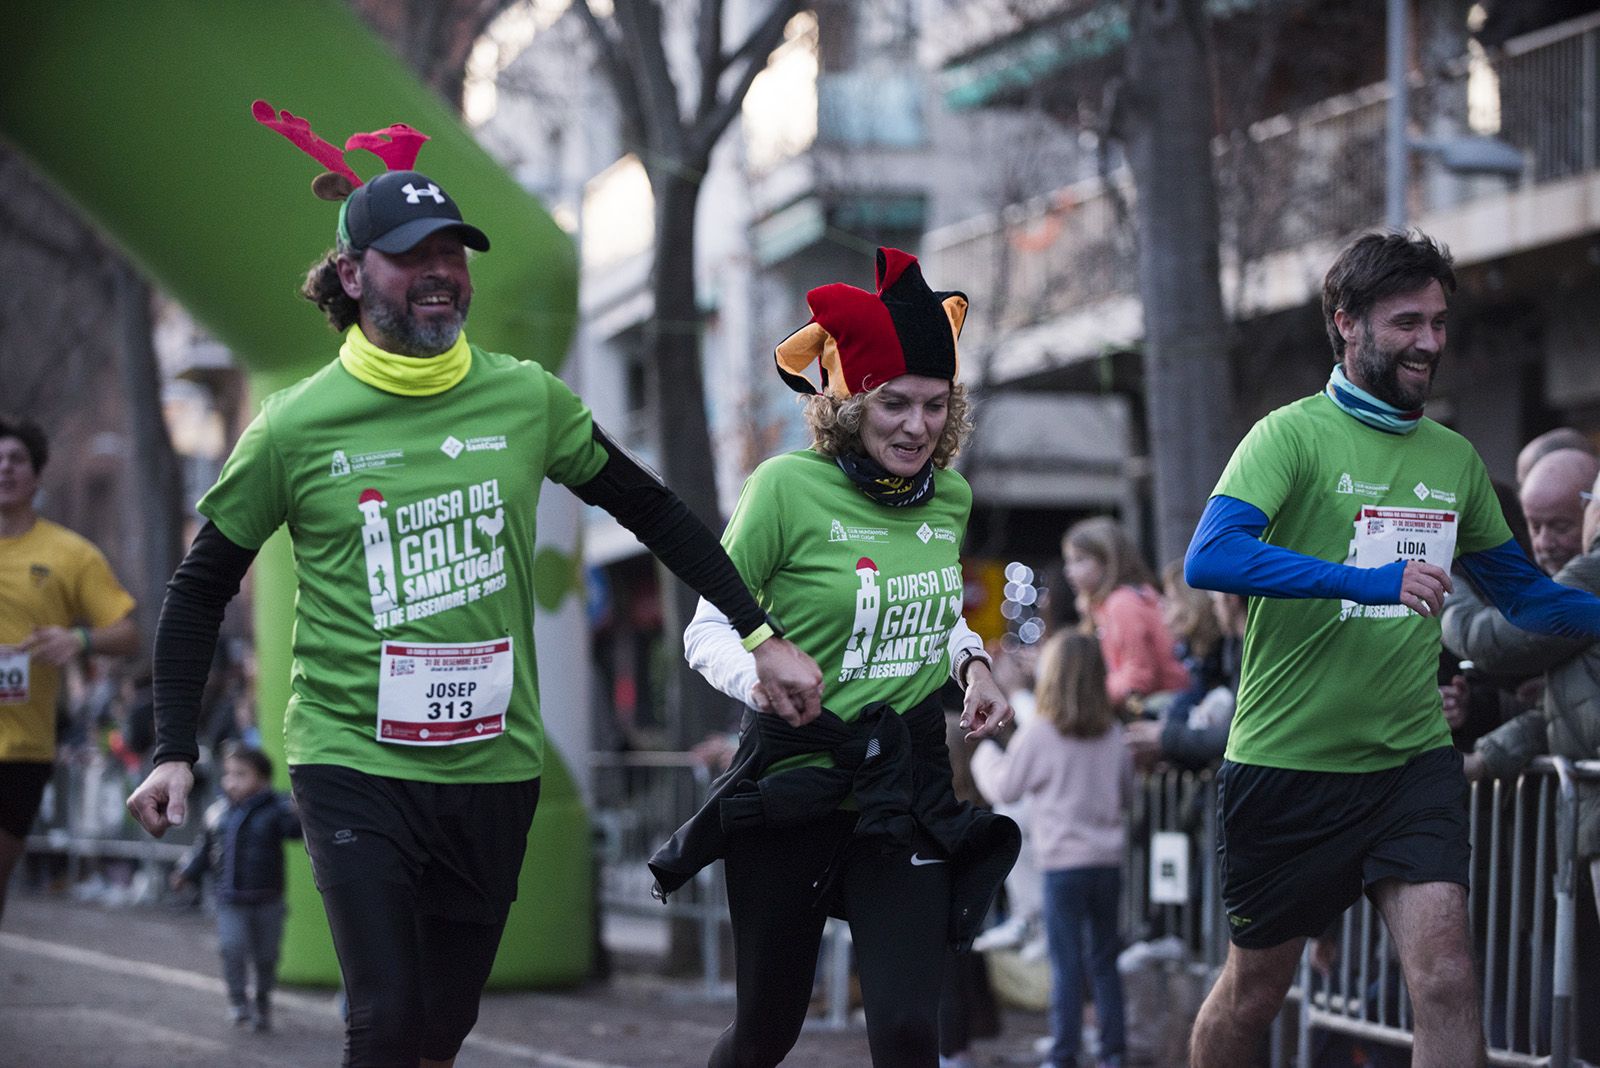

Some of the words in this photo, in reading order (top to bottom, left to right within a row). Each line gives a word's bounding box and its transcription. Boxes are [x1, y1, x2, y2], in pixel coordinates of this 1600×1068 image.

[396, 490, 464, 534] CURSA
[469, 479, 503, 513] DEL
[400, 518, 480, 576] GALL
[1396, 538, 1426, 556] LÍDIA
[403, 567, 451, 603] SANT
[454, 546, 505, 587] CUGAT
[887, 570, 940, 602] CURSA
[373, 611, 389, 630] 31
[390, 607, 405, 626] DE
[407, 590, 466, 621] DESEMBRE
[468, 584, 480, 603] DE
[483, 573, 506, 596] 2023
[1339, 607, 1353, 621] 31
[1352, 605, 1363, 617] DE
[1364, 604, 1409, 618] DESEMBRE
[881, 596, 947, 640] GALL
[872, 636, 918, 663] SANT
[838, 669, 853, 682] 31
[852, 667, 867, 679] DE
[426, 682, 477, 698] JOSEP
[427, 701, 473, 720] 313
